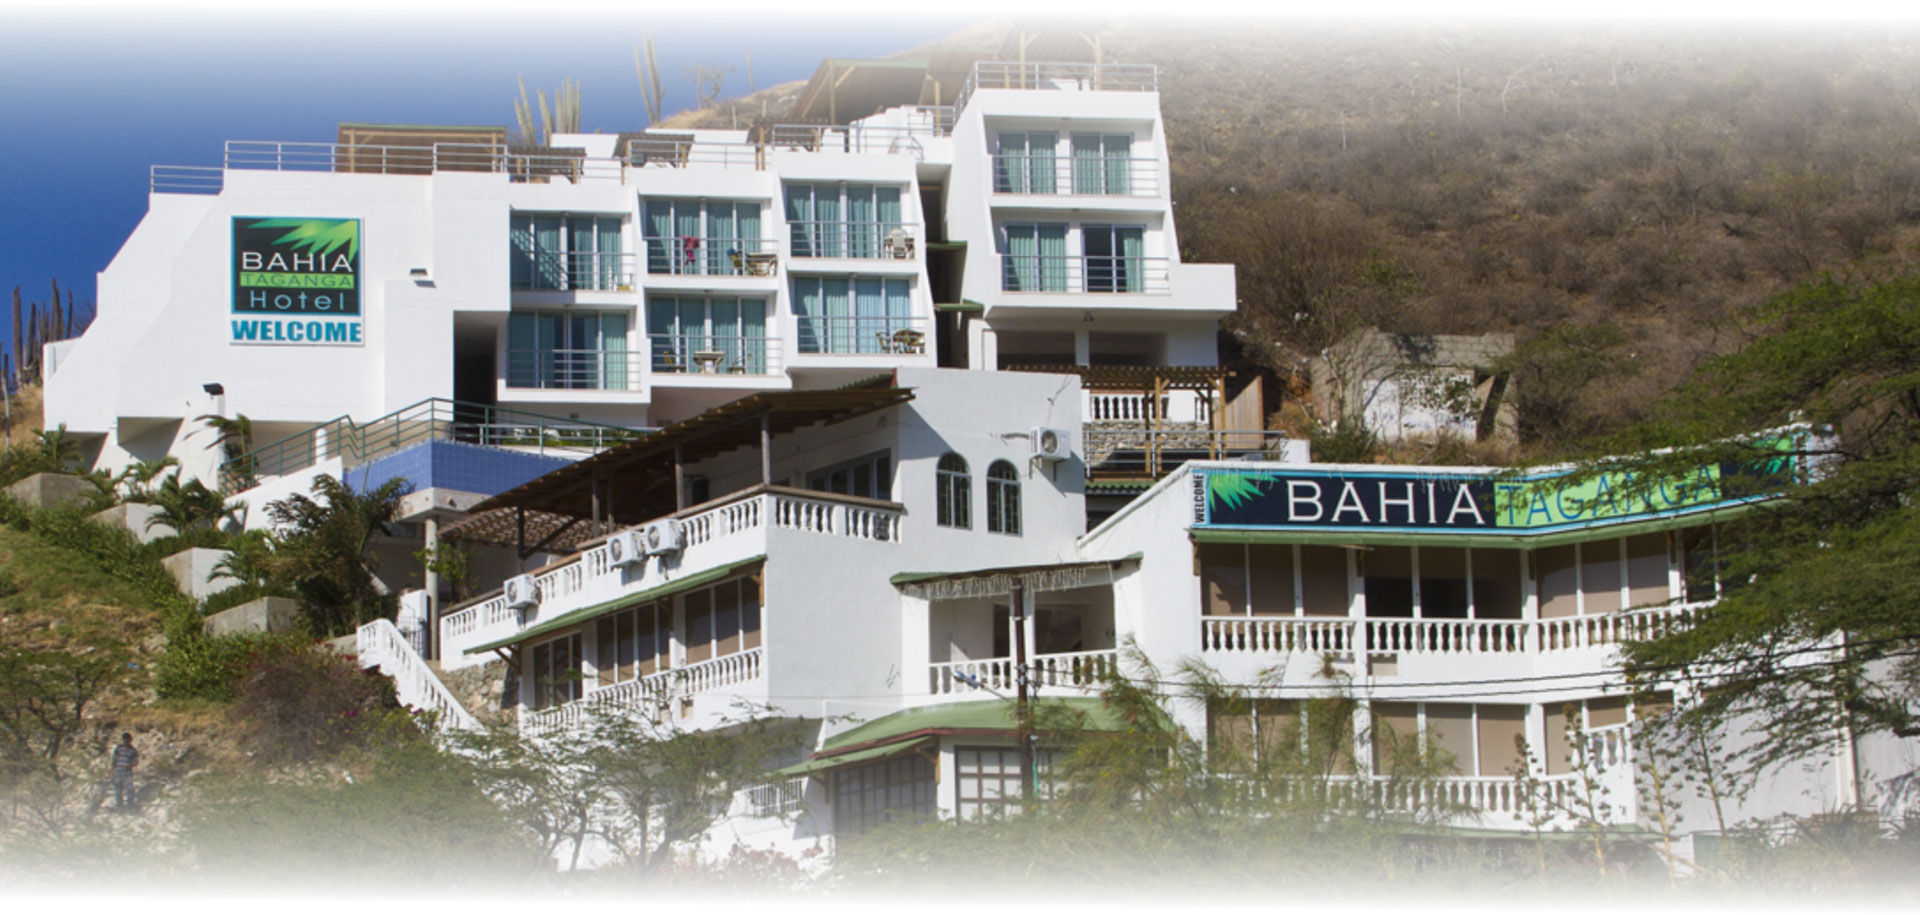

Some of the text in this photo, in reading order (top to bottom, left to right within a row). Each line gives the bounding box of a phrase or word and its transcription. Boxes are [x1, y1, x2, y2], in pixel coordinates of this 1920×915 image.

[242, 252, 353, 272] BAHIA
[243, 274, 352, 287] TAGANGA
[250, 290, 345, 310] Hotel
[231, 319, 362, 342] WELCOME
[1192, 474, 1205, 523] WELCOME
[1286, 464, 1718, 525] BAHIA TAGANGA
